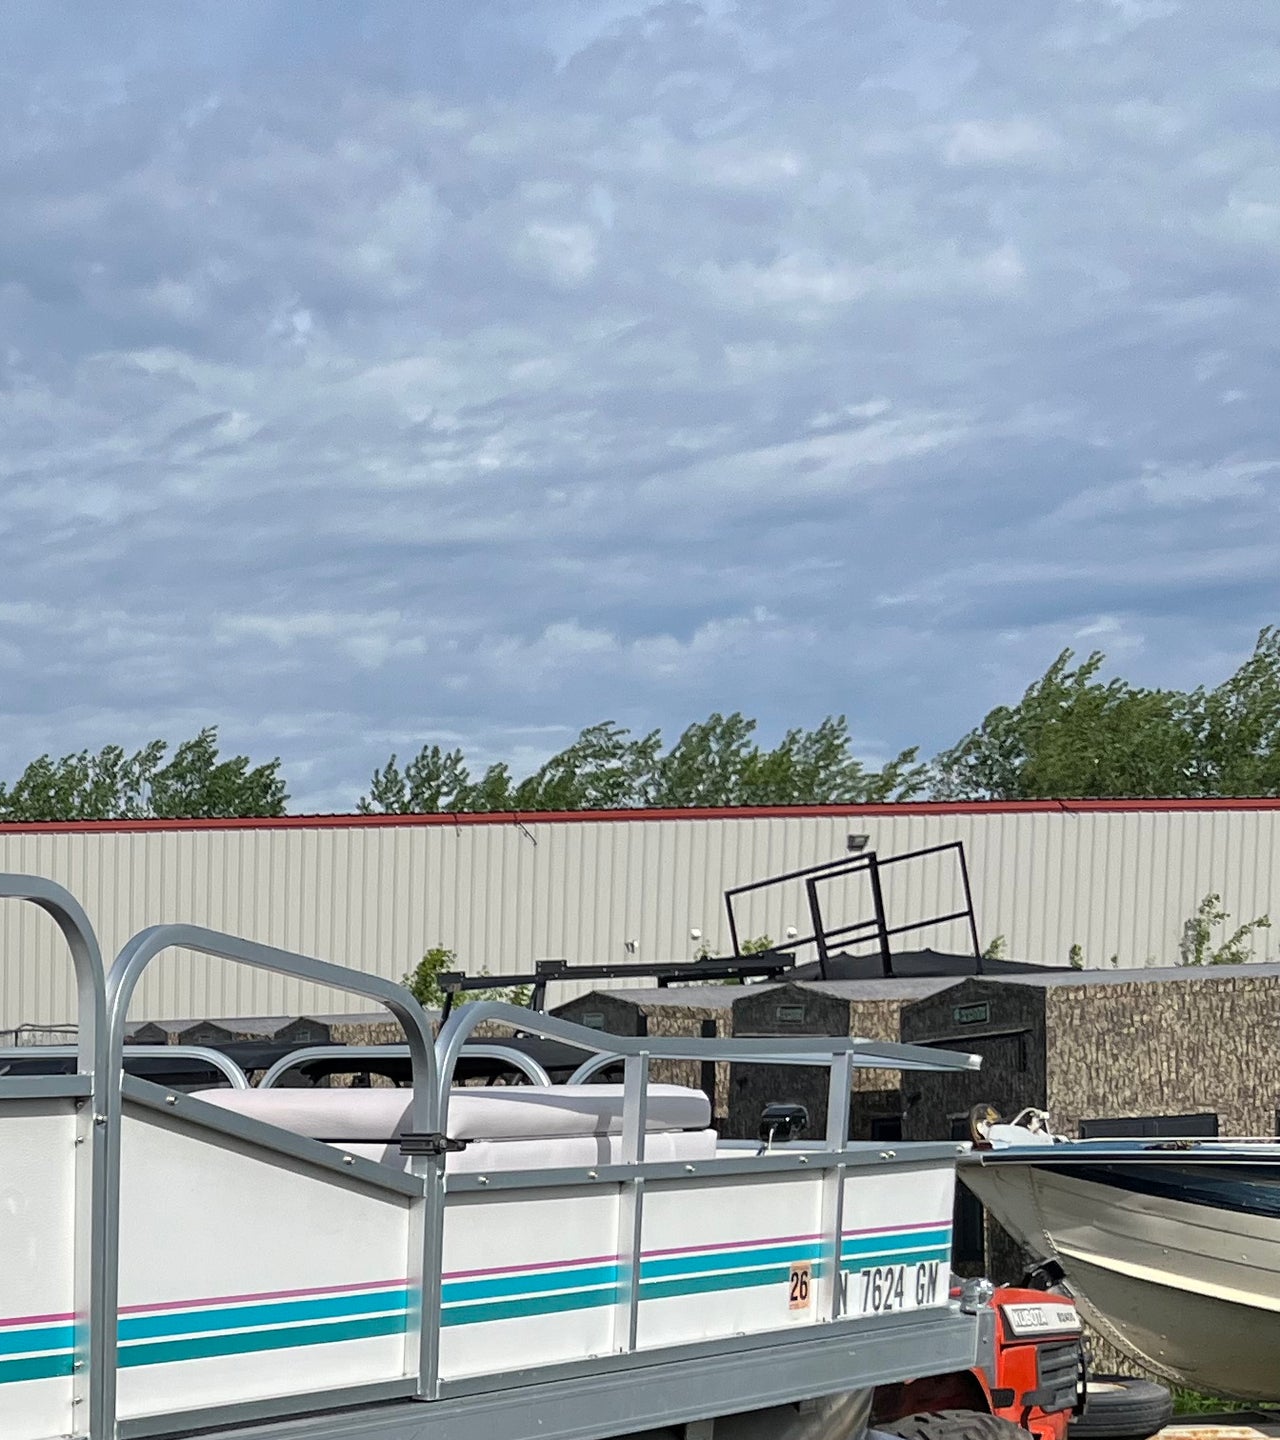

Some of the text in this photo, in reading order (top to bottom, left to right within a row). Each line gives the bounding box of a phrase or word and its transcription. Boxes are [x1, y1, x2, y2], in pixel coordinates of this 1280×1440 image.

[790, 1270, 809, 1302] 26
[861, 1265, 904, 1312] 7624
[915, 1261, 939, 1306] GN
[1011, 1307, 1048, 1328] KUBOTA
